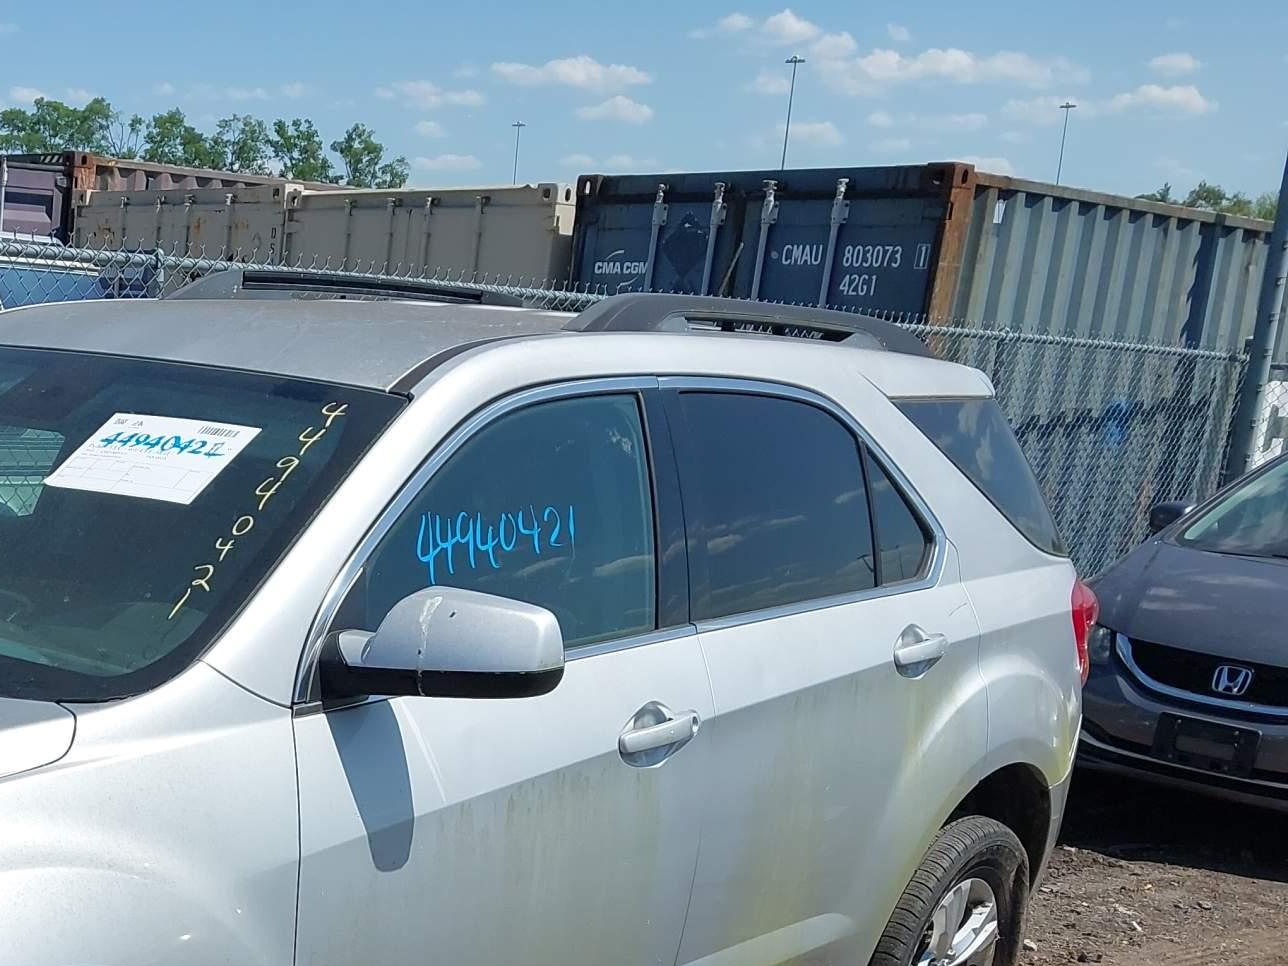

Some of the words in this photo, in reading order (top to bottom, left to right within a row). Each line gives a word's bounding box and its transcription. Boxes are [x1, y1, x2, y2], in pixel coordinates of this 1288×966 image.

[594, 262, 621, 274] CMA
[782, 244, 823, 265] CMAU
[843, 246, 903, 268] 803073
[839, 274, 877, 296] 42G1
[168, 402, 348, 620] 44940421
[417, 505, 575, 585] 44940421
